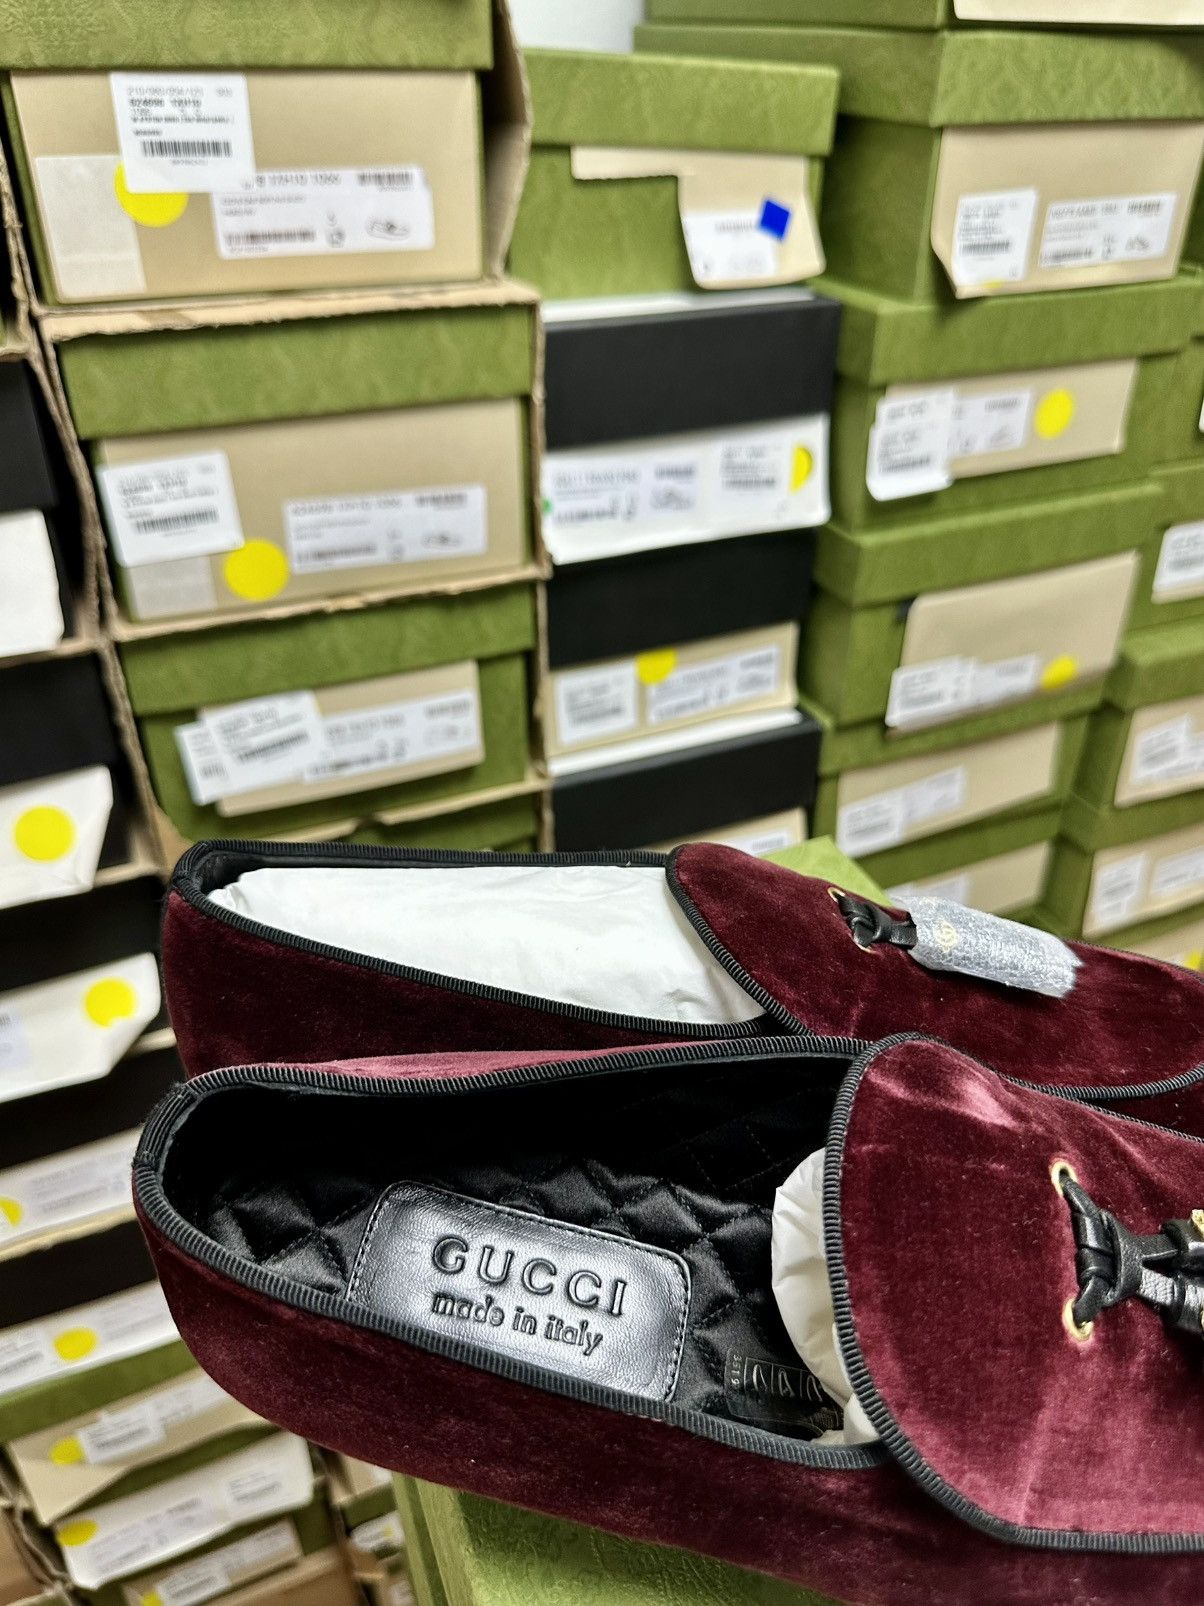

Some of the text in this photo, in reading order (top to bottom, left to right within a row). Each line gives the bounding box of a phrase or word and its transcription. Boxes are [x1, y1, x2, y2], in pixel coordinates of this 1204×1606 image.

[432, 1235, 627, 1317] GUCCI
[431, 1292, 603, 1356] made in italy
